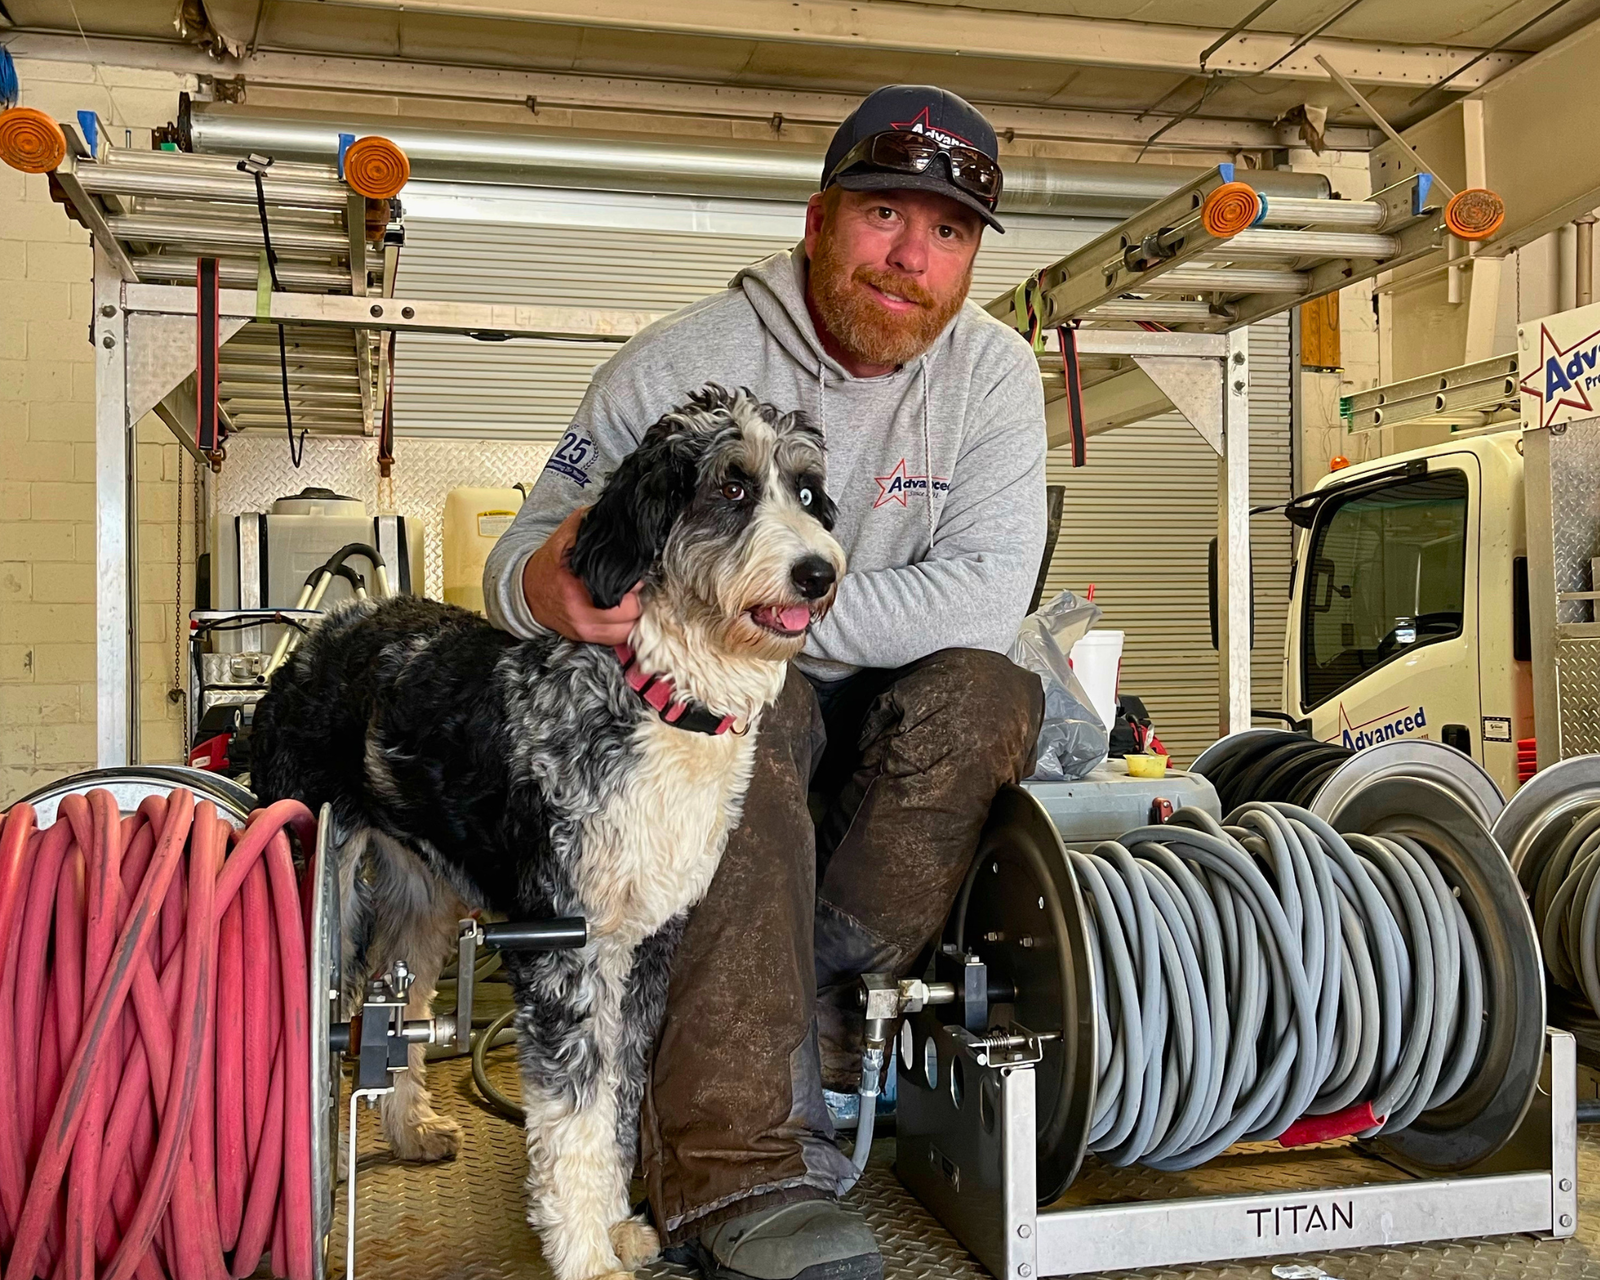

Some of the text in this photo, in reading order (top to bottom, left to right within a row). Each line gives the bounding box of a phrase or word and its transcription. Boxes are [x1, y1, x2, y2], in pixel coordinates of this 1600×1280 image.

[1545, 345, 1600, 403] Adv
[1585, 374, 1600, 391] Pr
[555, 432, 592, 464] 25
[1342, 706, 1427, 751] Advanced
[1246, 1201, 1353, 1237] TITAN
